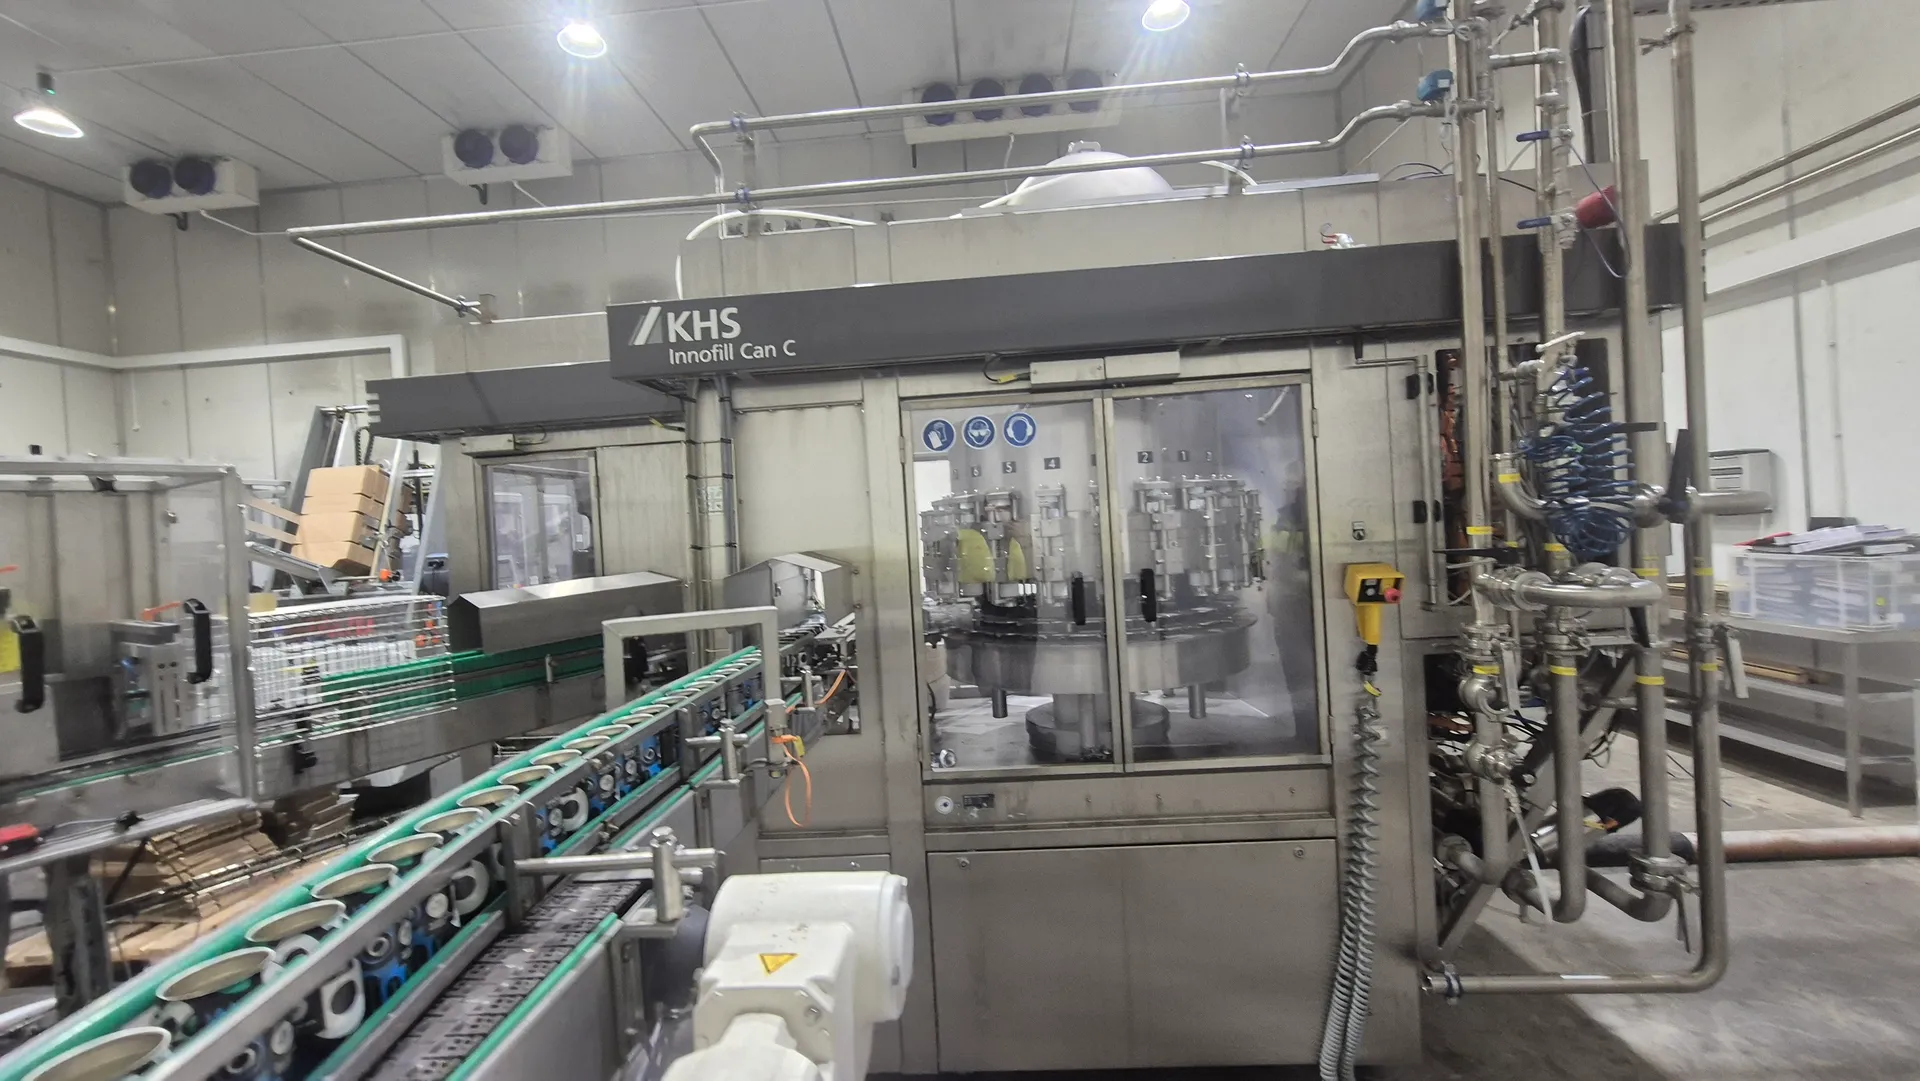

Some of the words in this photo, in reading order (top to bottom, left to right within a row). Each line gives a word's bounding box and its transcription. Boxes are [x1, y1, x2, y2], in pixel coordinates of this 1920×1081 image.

[667, 307, 742, 343] KHS
[669, 343, 734, 365] Innofill
[740, 343, 777, 360] Can
[782, 339, 797, 357] C
